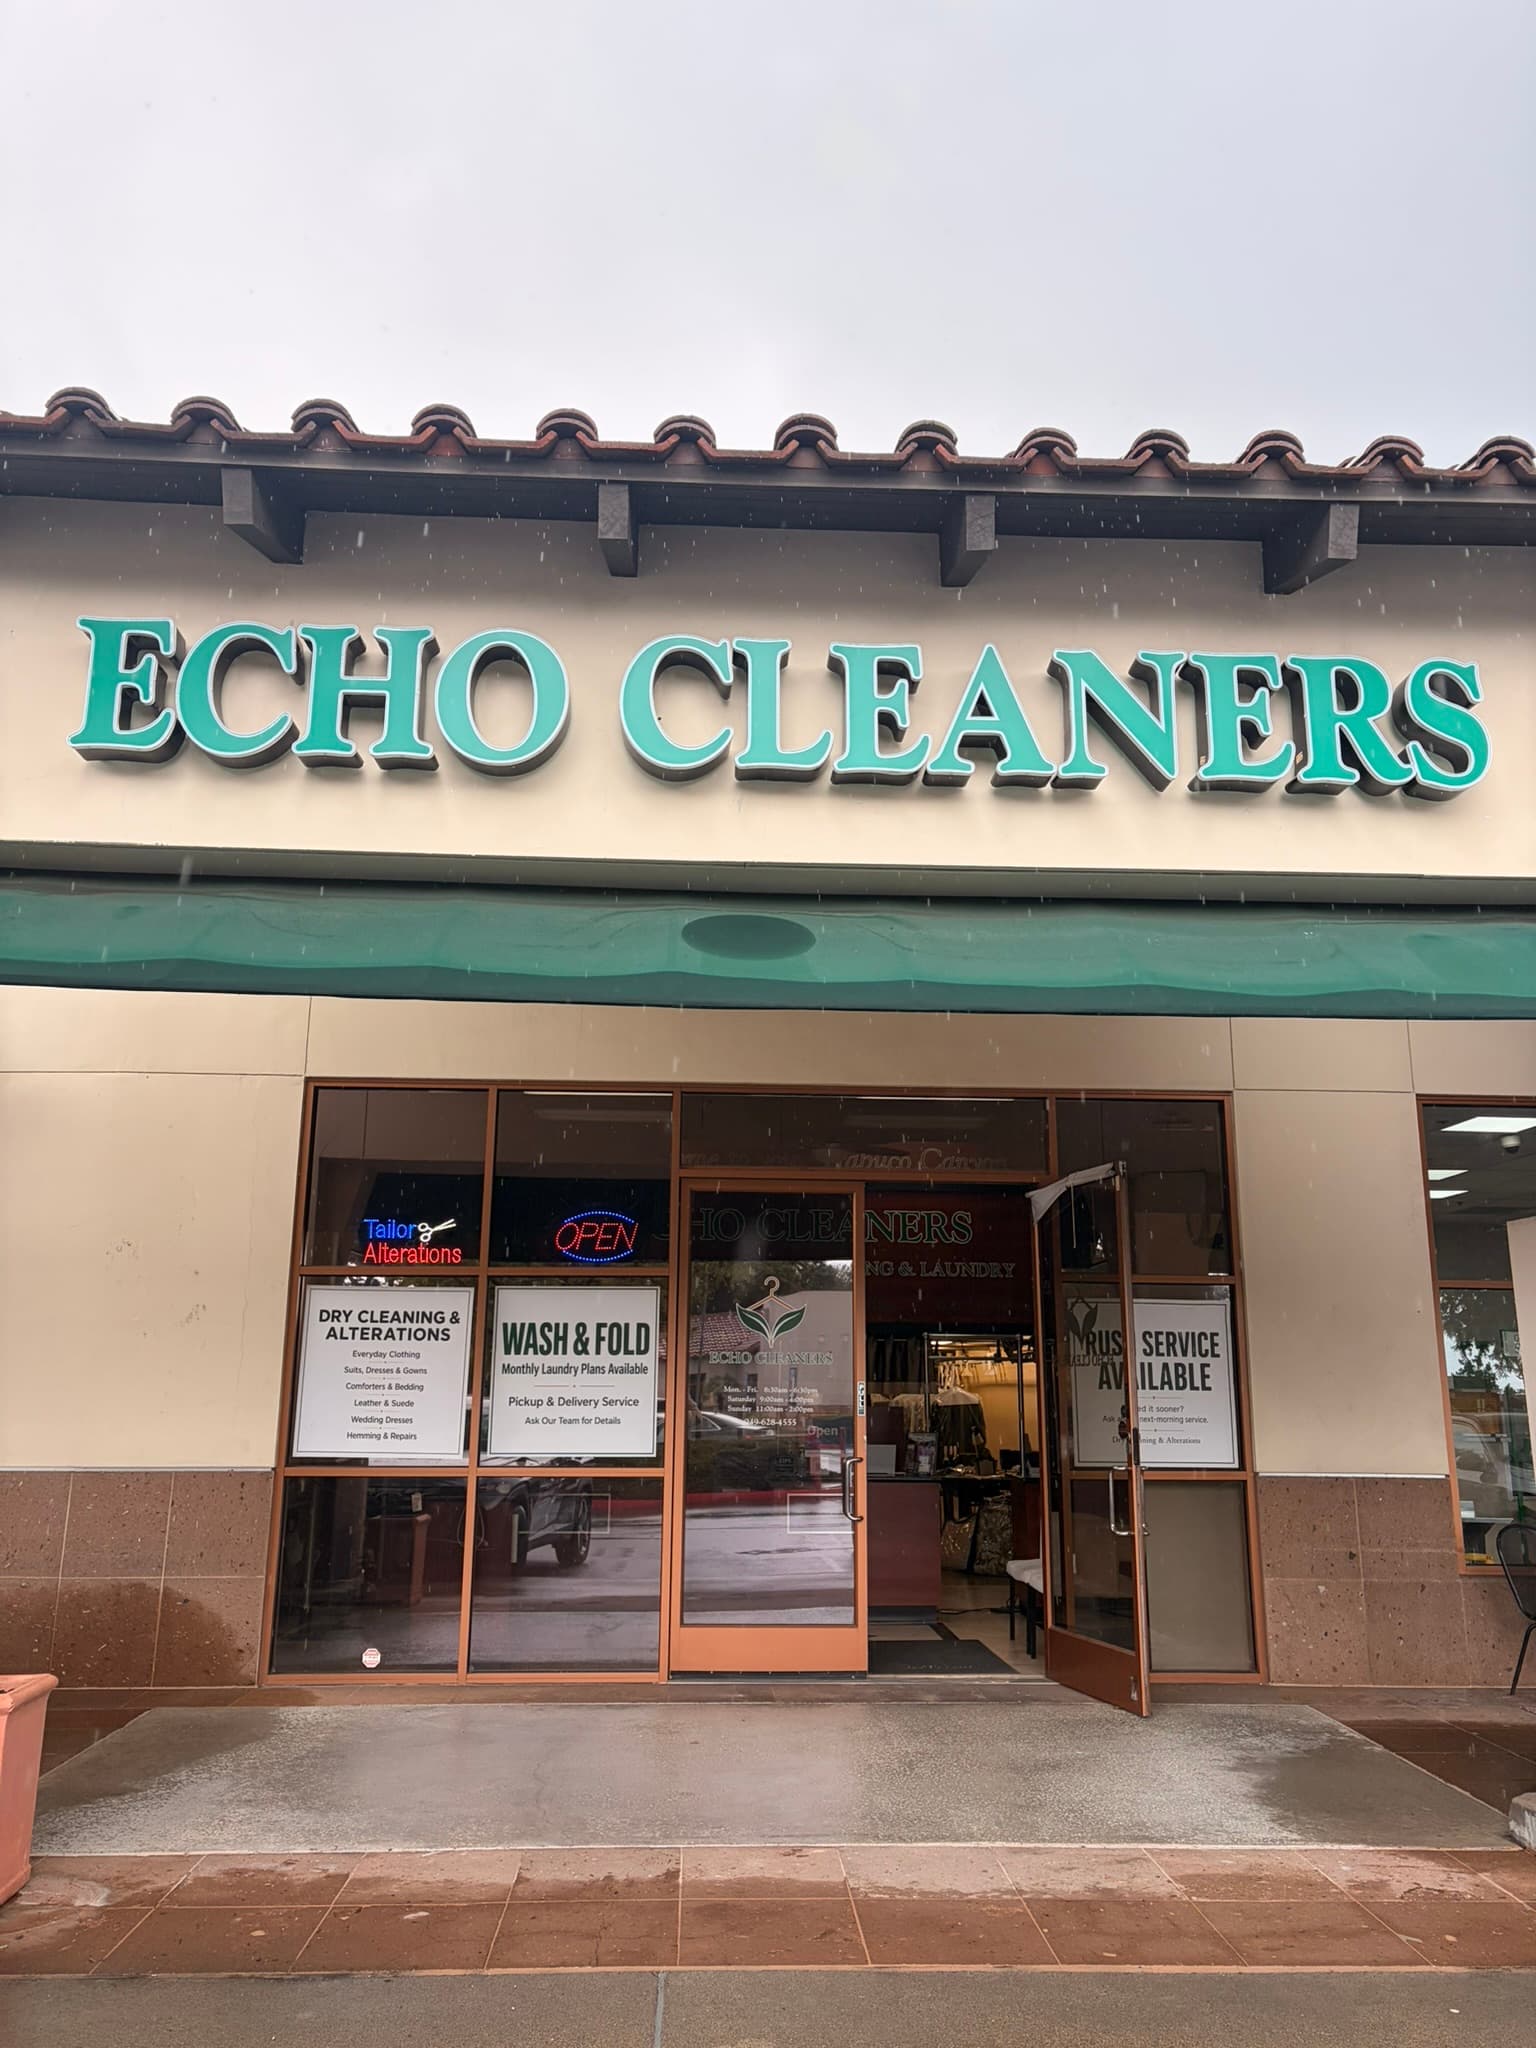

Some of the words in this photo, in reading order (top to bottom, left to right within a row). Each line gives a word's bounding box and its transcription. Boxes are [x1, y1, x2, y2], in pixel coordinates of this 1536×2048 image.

[66, 616, 571, 772] ECHO
[619, 634, 1492, 795] CLEANERS
[363, 1218, 417, 1240] Tailor
[555, 1221, 639, 1251] OPEN
[363, 1244, 462, 1264] Alterations
[920, 1259, 1016, 1278] LAUNDRY
[319, 1309, 353, 1323] DRY
[357, 1310, 446, 1324] CLEANING
[449, 1311, 460, 1324] &
[325, 1326, 451, 1341] ALTERATIONS
[502, 1321, 569, 1356] WASH
[573, 1321, 590, 1356] &
[595, 1321, 650, 1356] FOLD
[1086, 1330, 1124, 1356] RUS
[1142, 1330, 1221, 1358] SERVICE
[352, 1350, 387, 1359] Everyday
[389, 1351, 420, 1359] Clothing
[709, 1351, 753, 1365] ECHO
[755, 1351, 833, 1365] CLEANERS
[344, 1366, 364, 1375] Suits,
[366, 1367, 394, 1375] Dresses
[395, 1367, 401, 1375] &
[403, 1367, 428, 1375] Gowns
[501, 1363, 540, 1377] Monthly
[542, 1363, 579, 1377] Laundry
[581, 1363, 606, 1375] Plans
[608, 1363, 649, 1375] Available
[1098, 1362, 1213, 1391] AVILABLE
[345, 1382, 385, 1390] Comforters
[395, 1383, 424, 1392] Bedding
[508, 1396, 544, 1408] Pickup
[546, 1397, 554, 1407] &
[557, 1396, 600, 1408] Delivery
[602, 1396, 640, 1407] Service
[728, 1395, 756, 1403] Saturday
[1156, 1405, 1184, 1413] sooner?
[351, 1416, 384, 1424] Wedding
[385, 1416, 413, 1424] Dresses
[525, 1416, 540, 1424] Ask
[541, 1416, 556, 1424] Our
[559, 1416, 580, 1424] Team
[581, 1416, 592, 1424] for
[594, 1416, 621, 1424] Details
[347, 1432, 381, 1440] Hemming
[390, 1432, 417, 1440] Repairs
[807, 1425, 839, 1439] Open
[1166, 1436, 1201, 1444] Alterations
